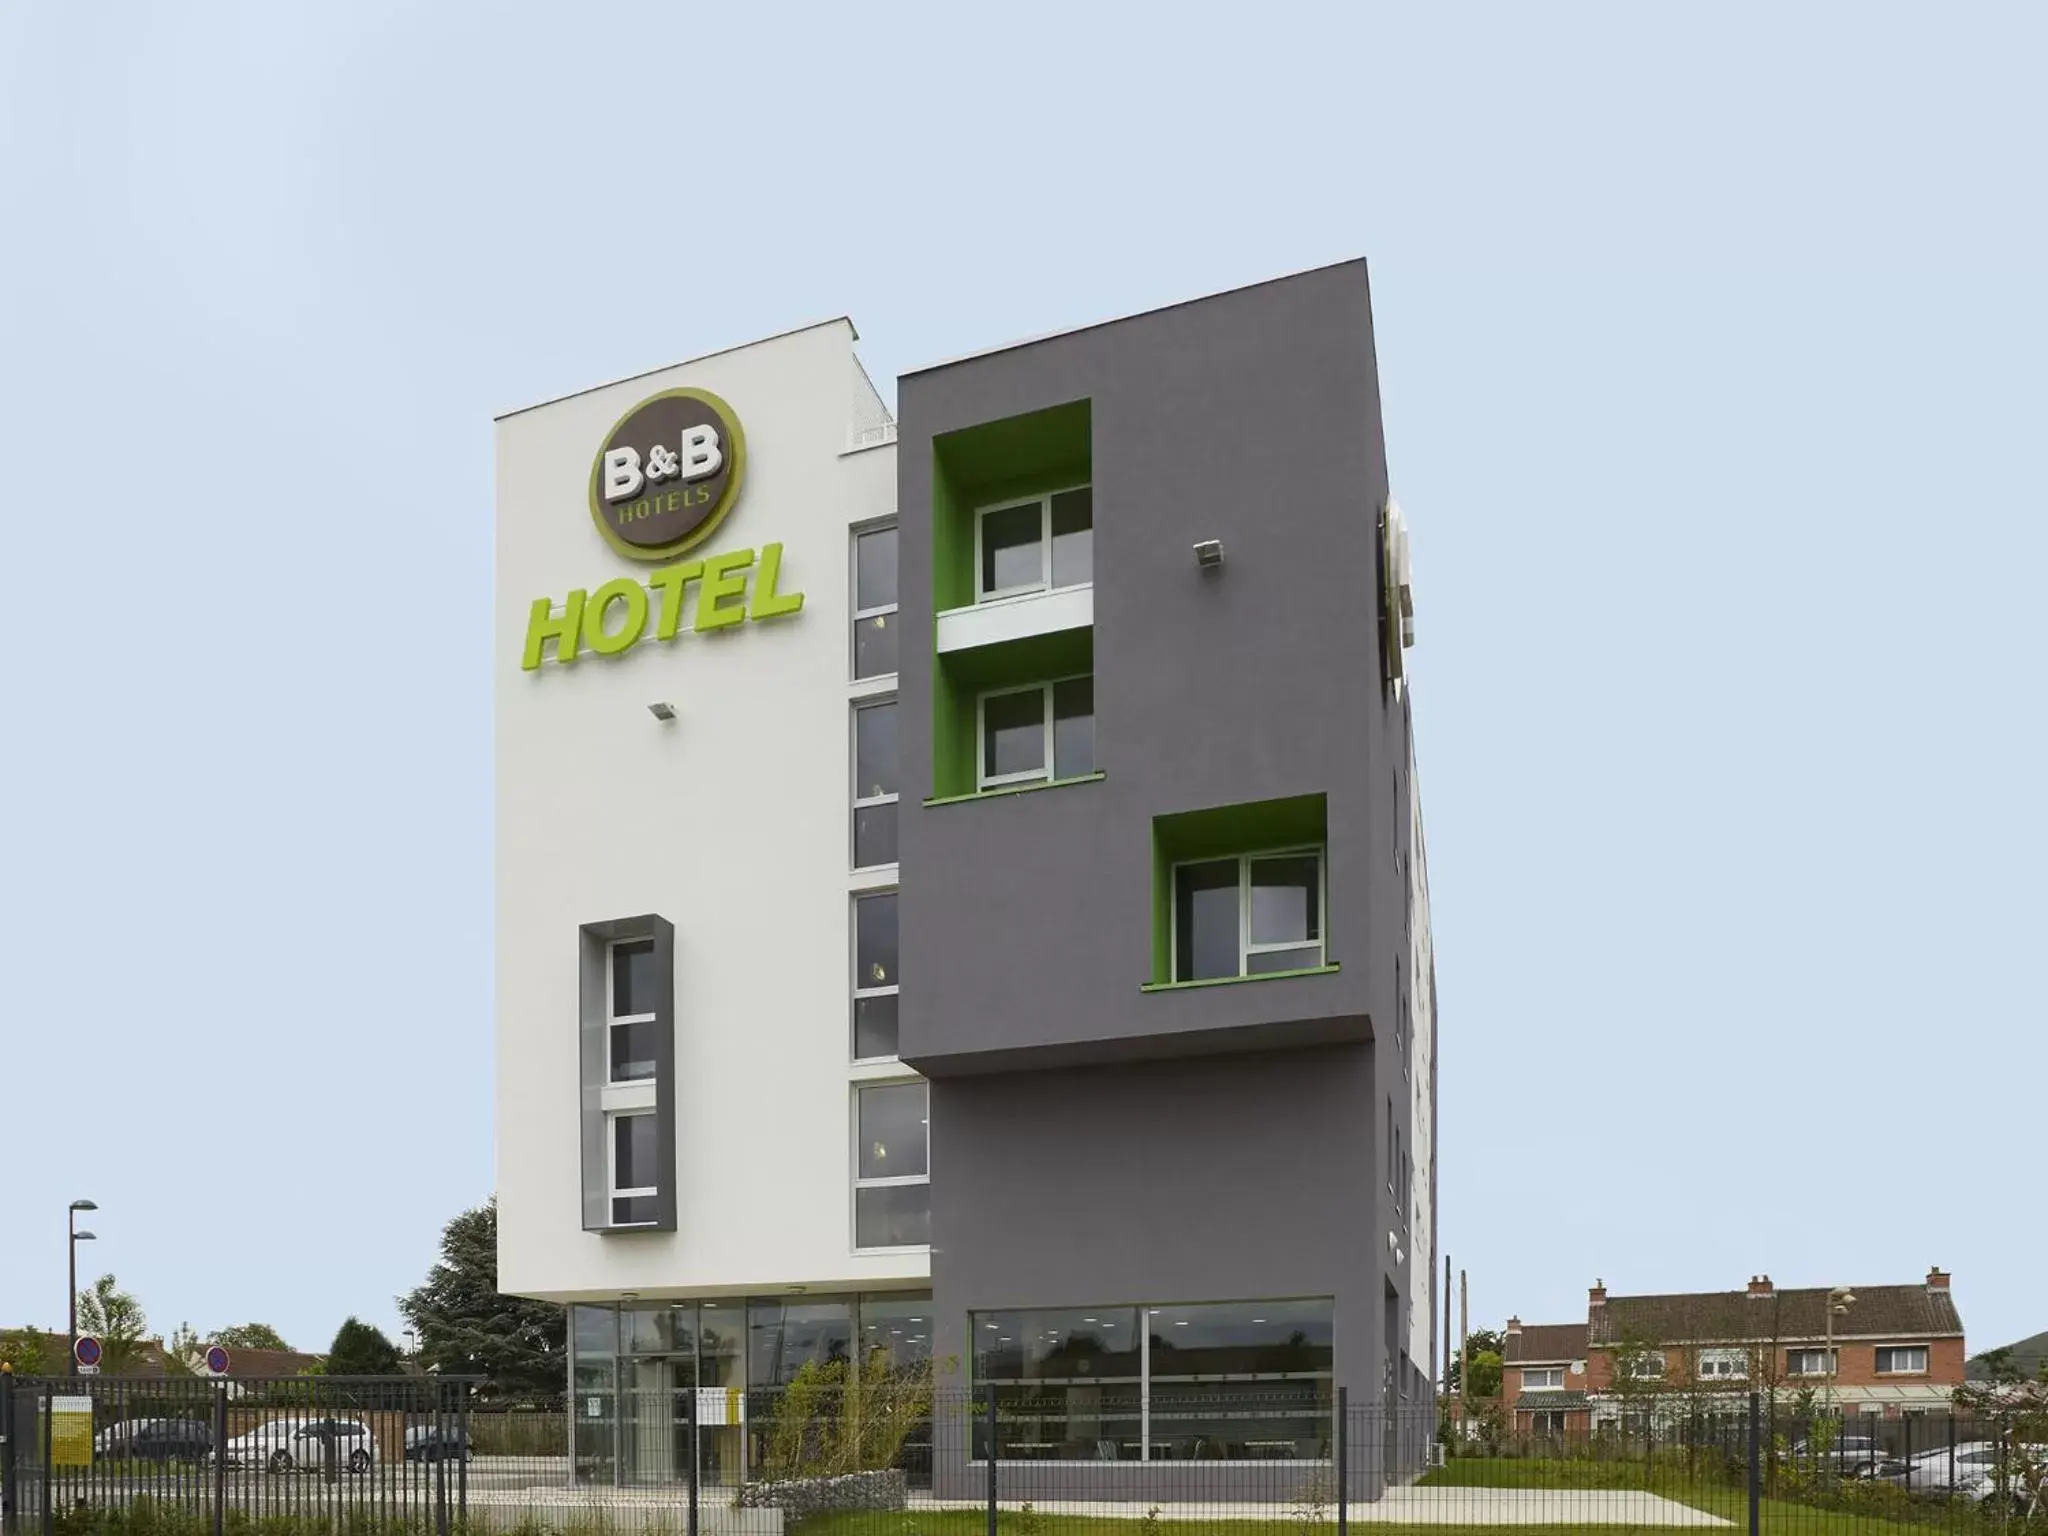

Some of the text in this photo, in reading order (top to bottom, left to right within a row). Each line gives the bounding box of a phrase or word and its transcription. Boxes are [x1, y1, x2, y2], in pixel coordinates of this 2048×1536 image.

[604, 423, 723, 501] B&B
[617, 484, 711, 525] HOTELS
[521, 542, 805, 672] HOTEL
